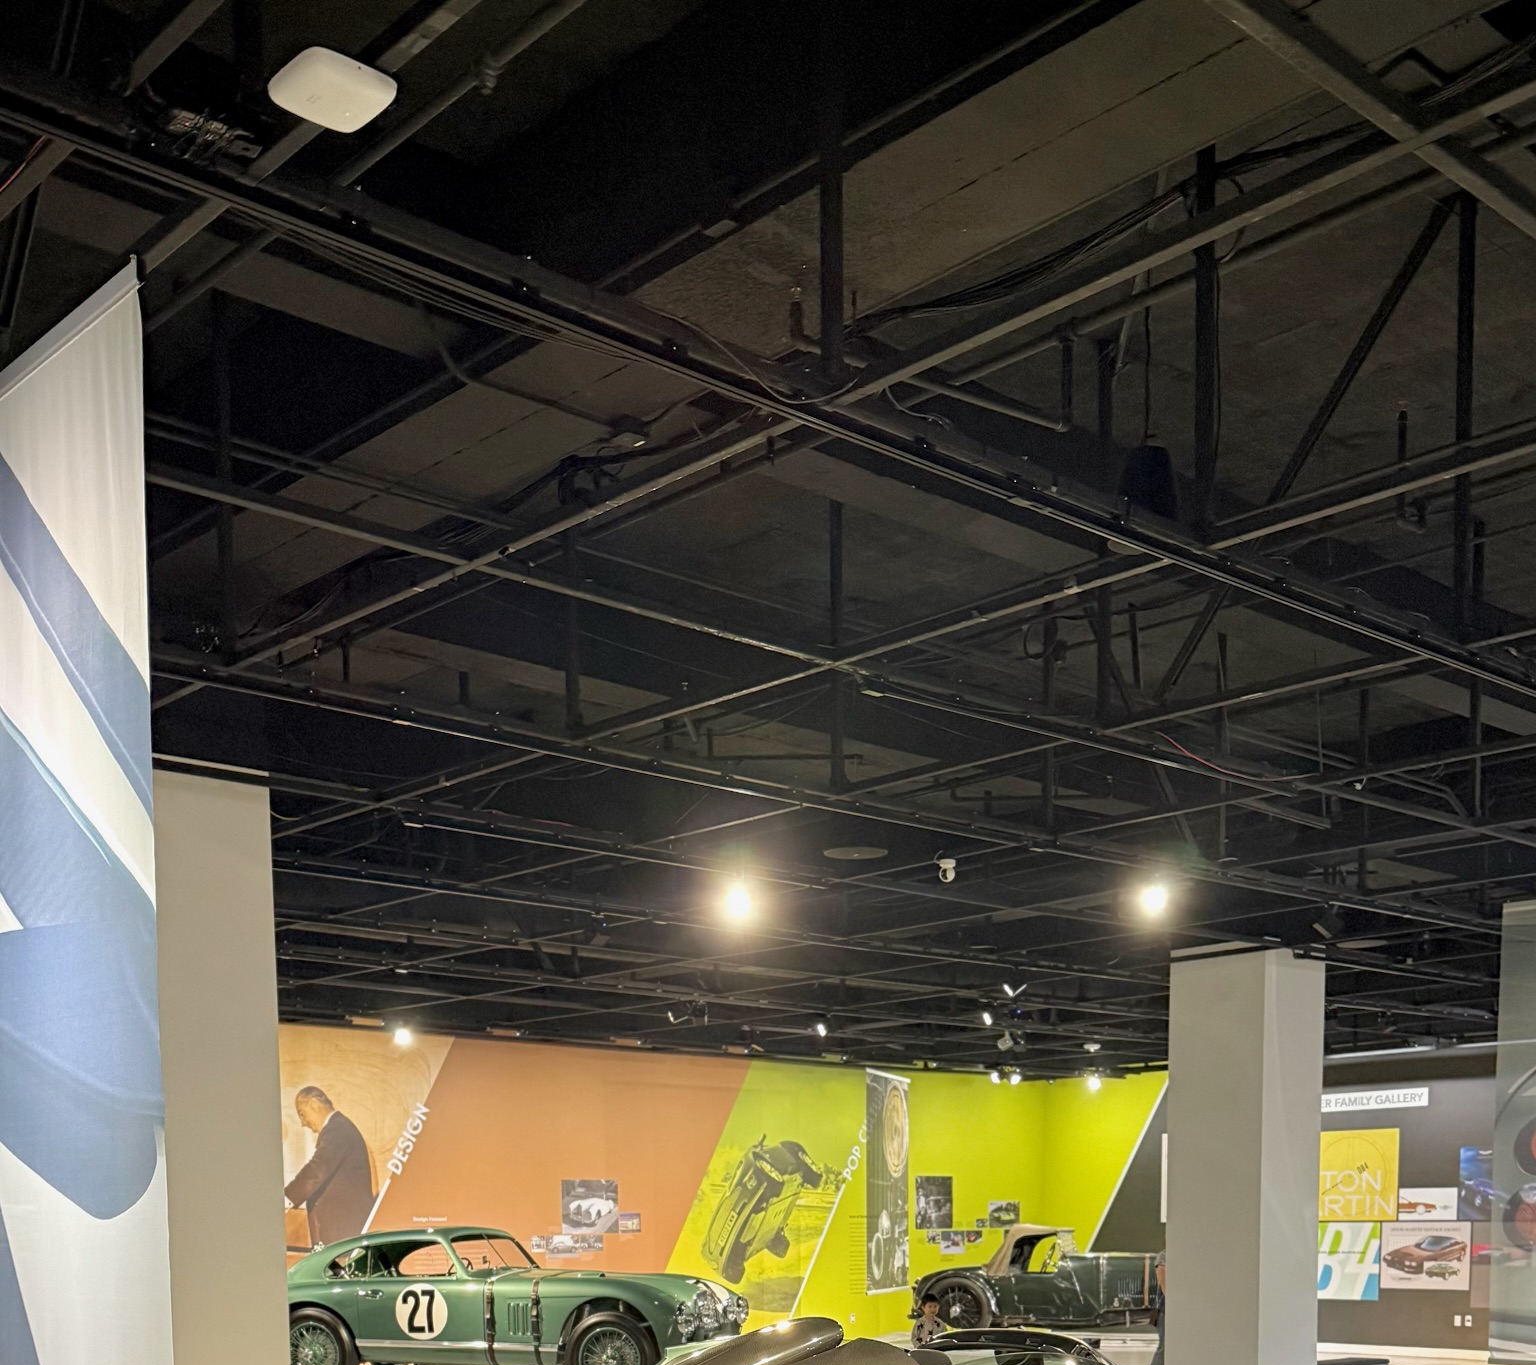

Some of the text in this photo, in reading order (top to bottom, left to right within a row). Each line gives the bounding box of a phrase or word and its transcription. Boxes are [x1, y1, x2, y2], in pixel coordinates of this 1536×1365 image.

[1334, 1095, 1373, 1108] FAMILY
[1374, 1092, 1424, 1105] GALLERY
[386, 1102, 431, 1176] DESIGN
[842, 1145, 862, 1182] POP
[402, 1289, 435, 1334] 27
